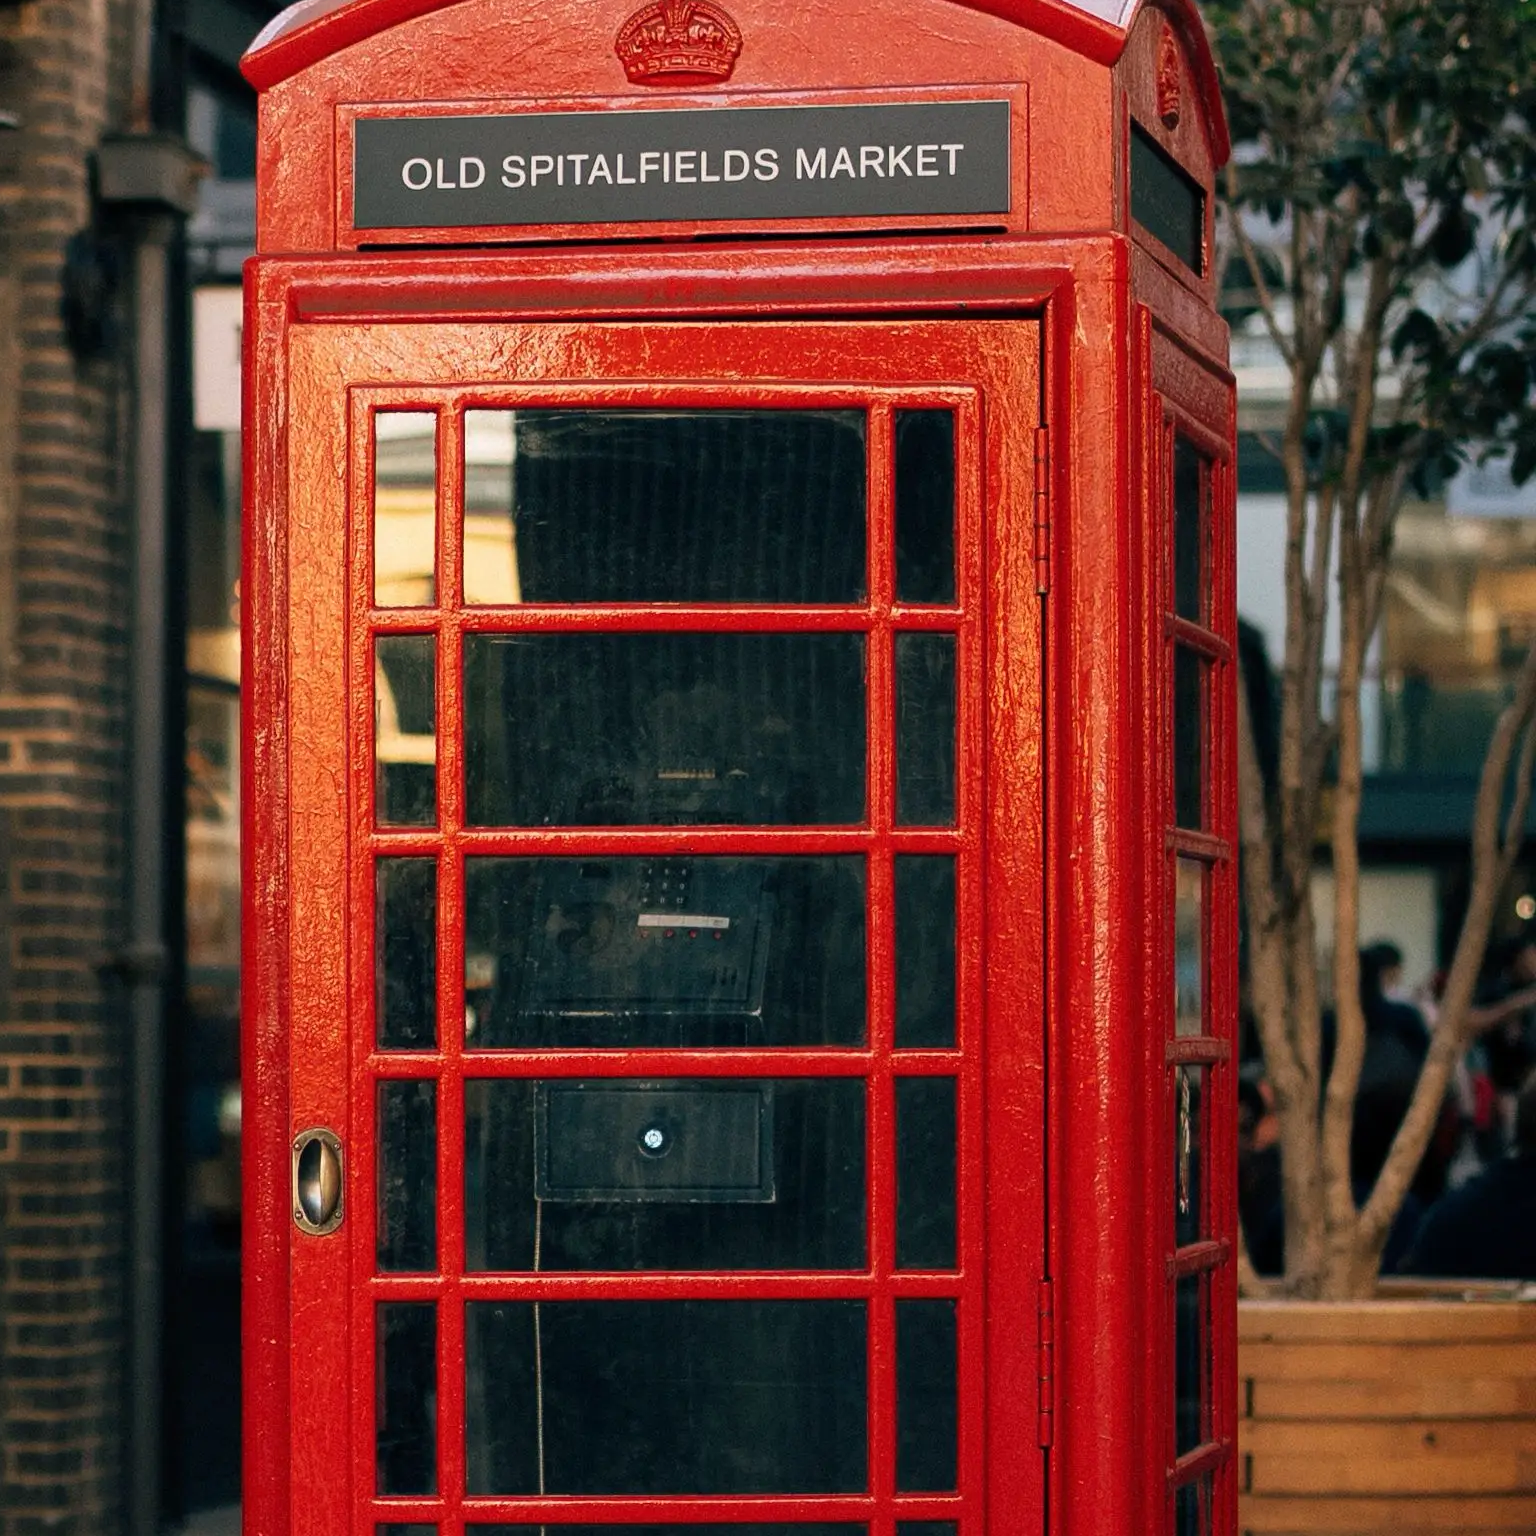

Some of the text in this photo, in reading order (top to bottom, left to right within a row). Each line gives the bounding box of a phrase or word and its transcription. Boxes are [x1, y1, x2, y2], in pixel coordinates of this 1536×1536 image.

[401, 143, 965, 191] OLD SPITALFIELDS MARKET
